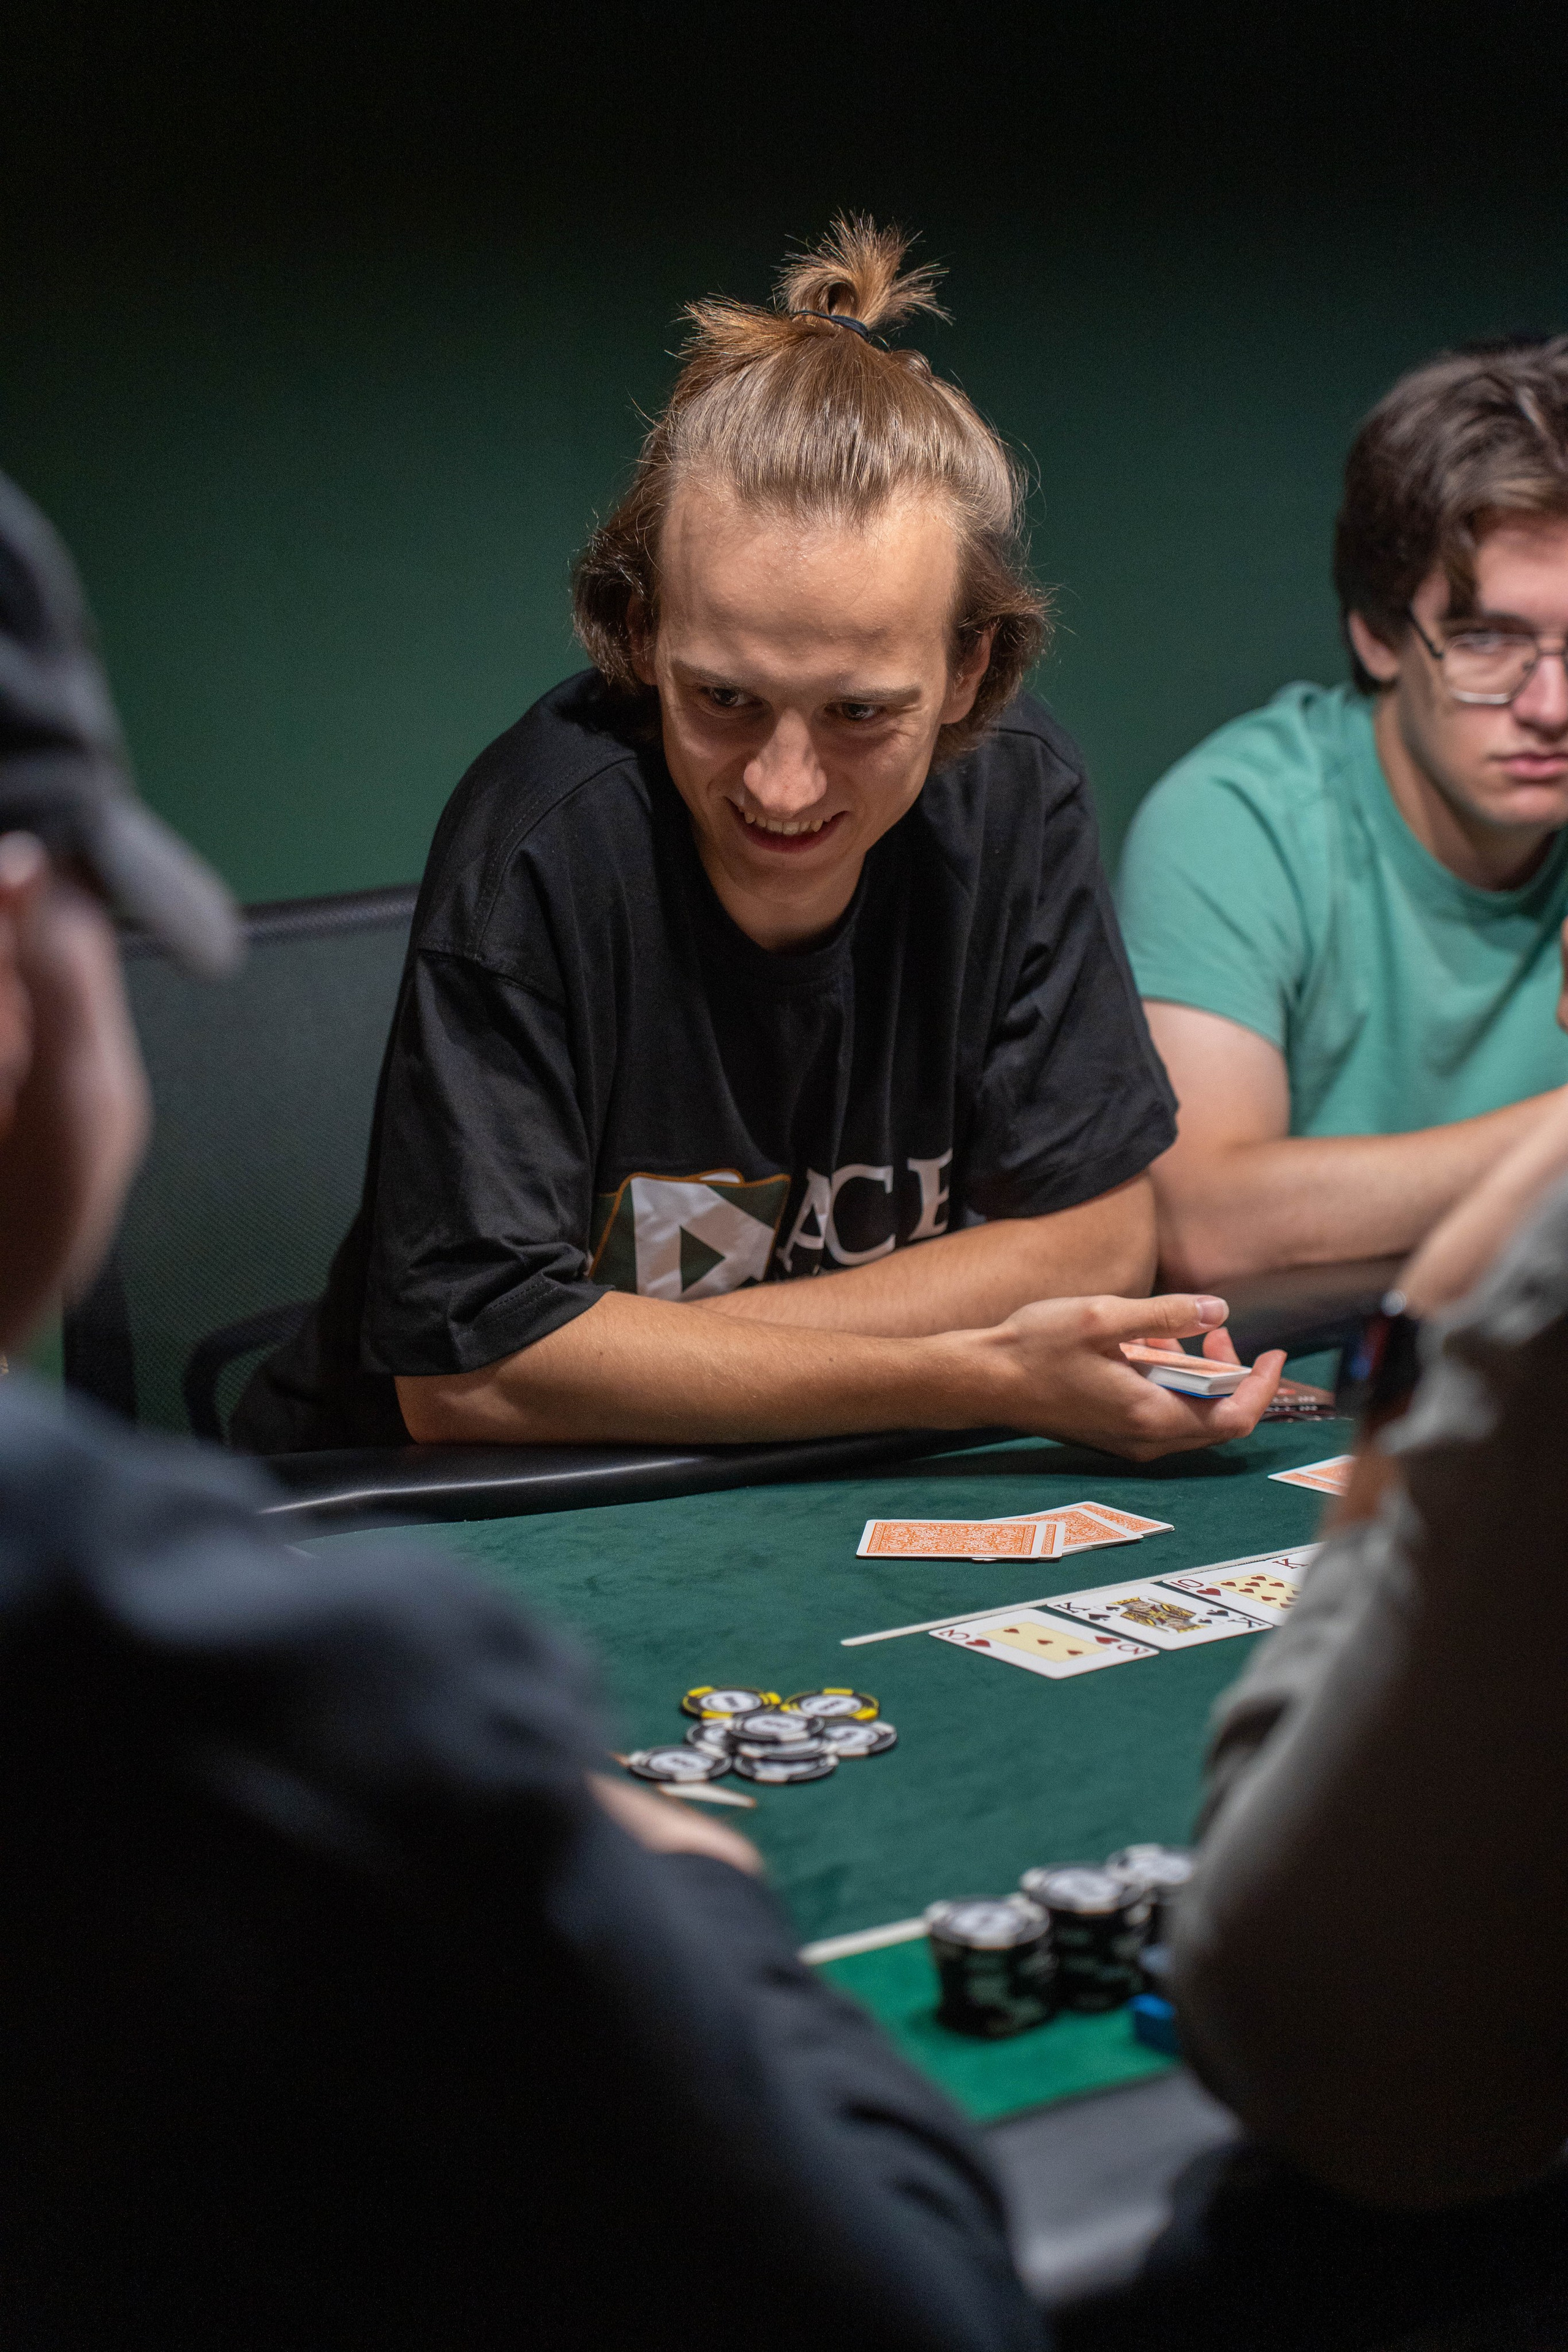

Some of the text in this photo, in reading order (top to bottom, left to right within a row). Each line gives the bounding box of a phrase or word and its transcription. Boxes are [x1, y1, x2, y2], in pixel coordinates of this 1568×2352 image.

[1272, 1558, 1310, 1569] K
[1170, 1578, 1204, 1589] 10
[1054, 1602, 1091, 1613] K
[1227, 1617, 1265, 1628] K
